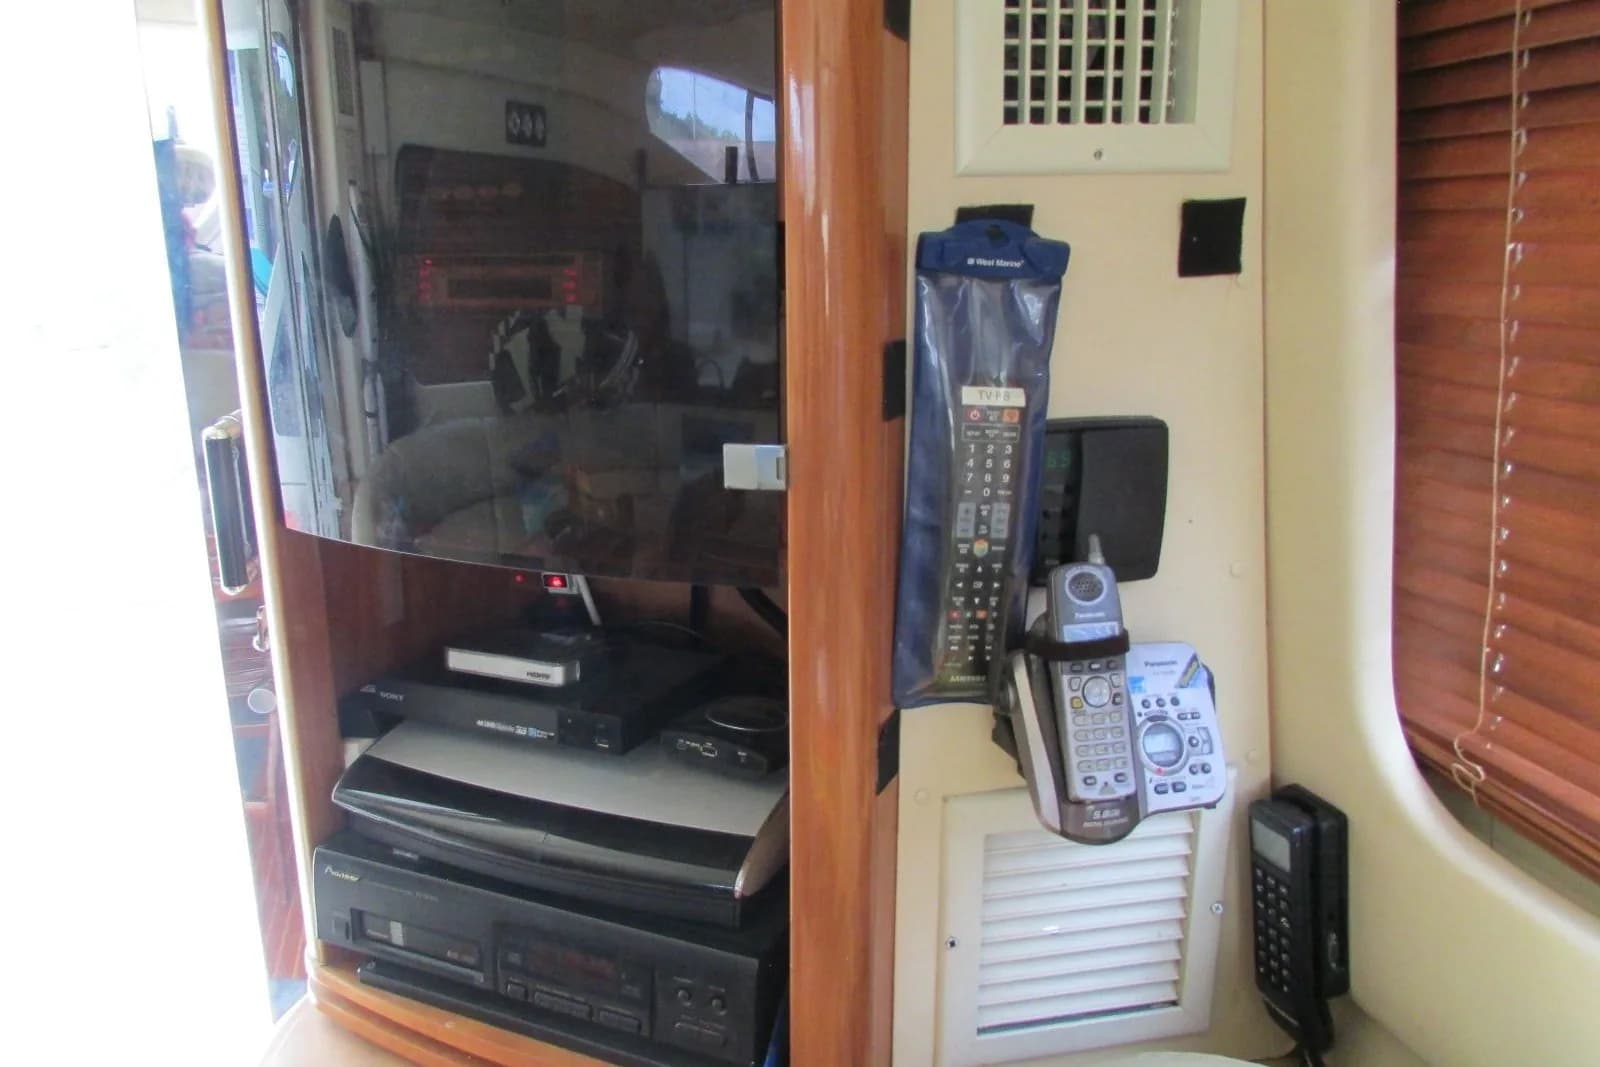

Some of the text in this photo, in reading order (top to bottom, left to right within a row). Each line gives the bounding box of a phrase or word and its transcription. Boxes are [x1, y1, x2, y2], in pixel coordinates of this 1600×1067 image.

[976, 258, 994, 267] West
[969, 443, 1012, 454] 1 2 3
[967, 458, 1011, 469] 4 5 6
[967, 473, 1010, 482] 7 8 9
